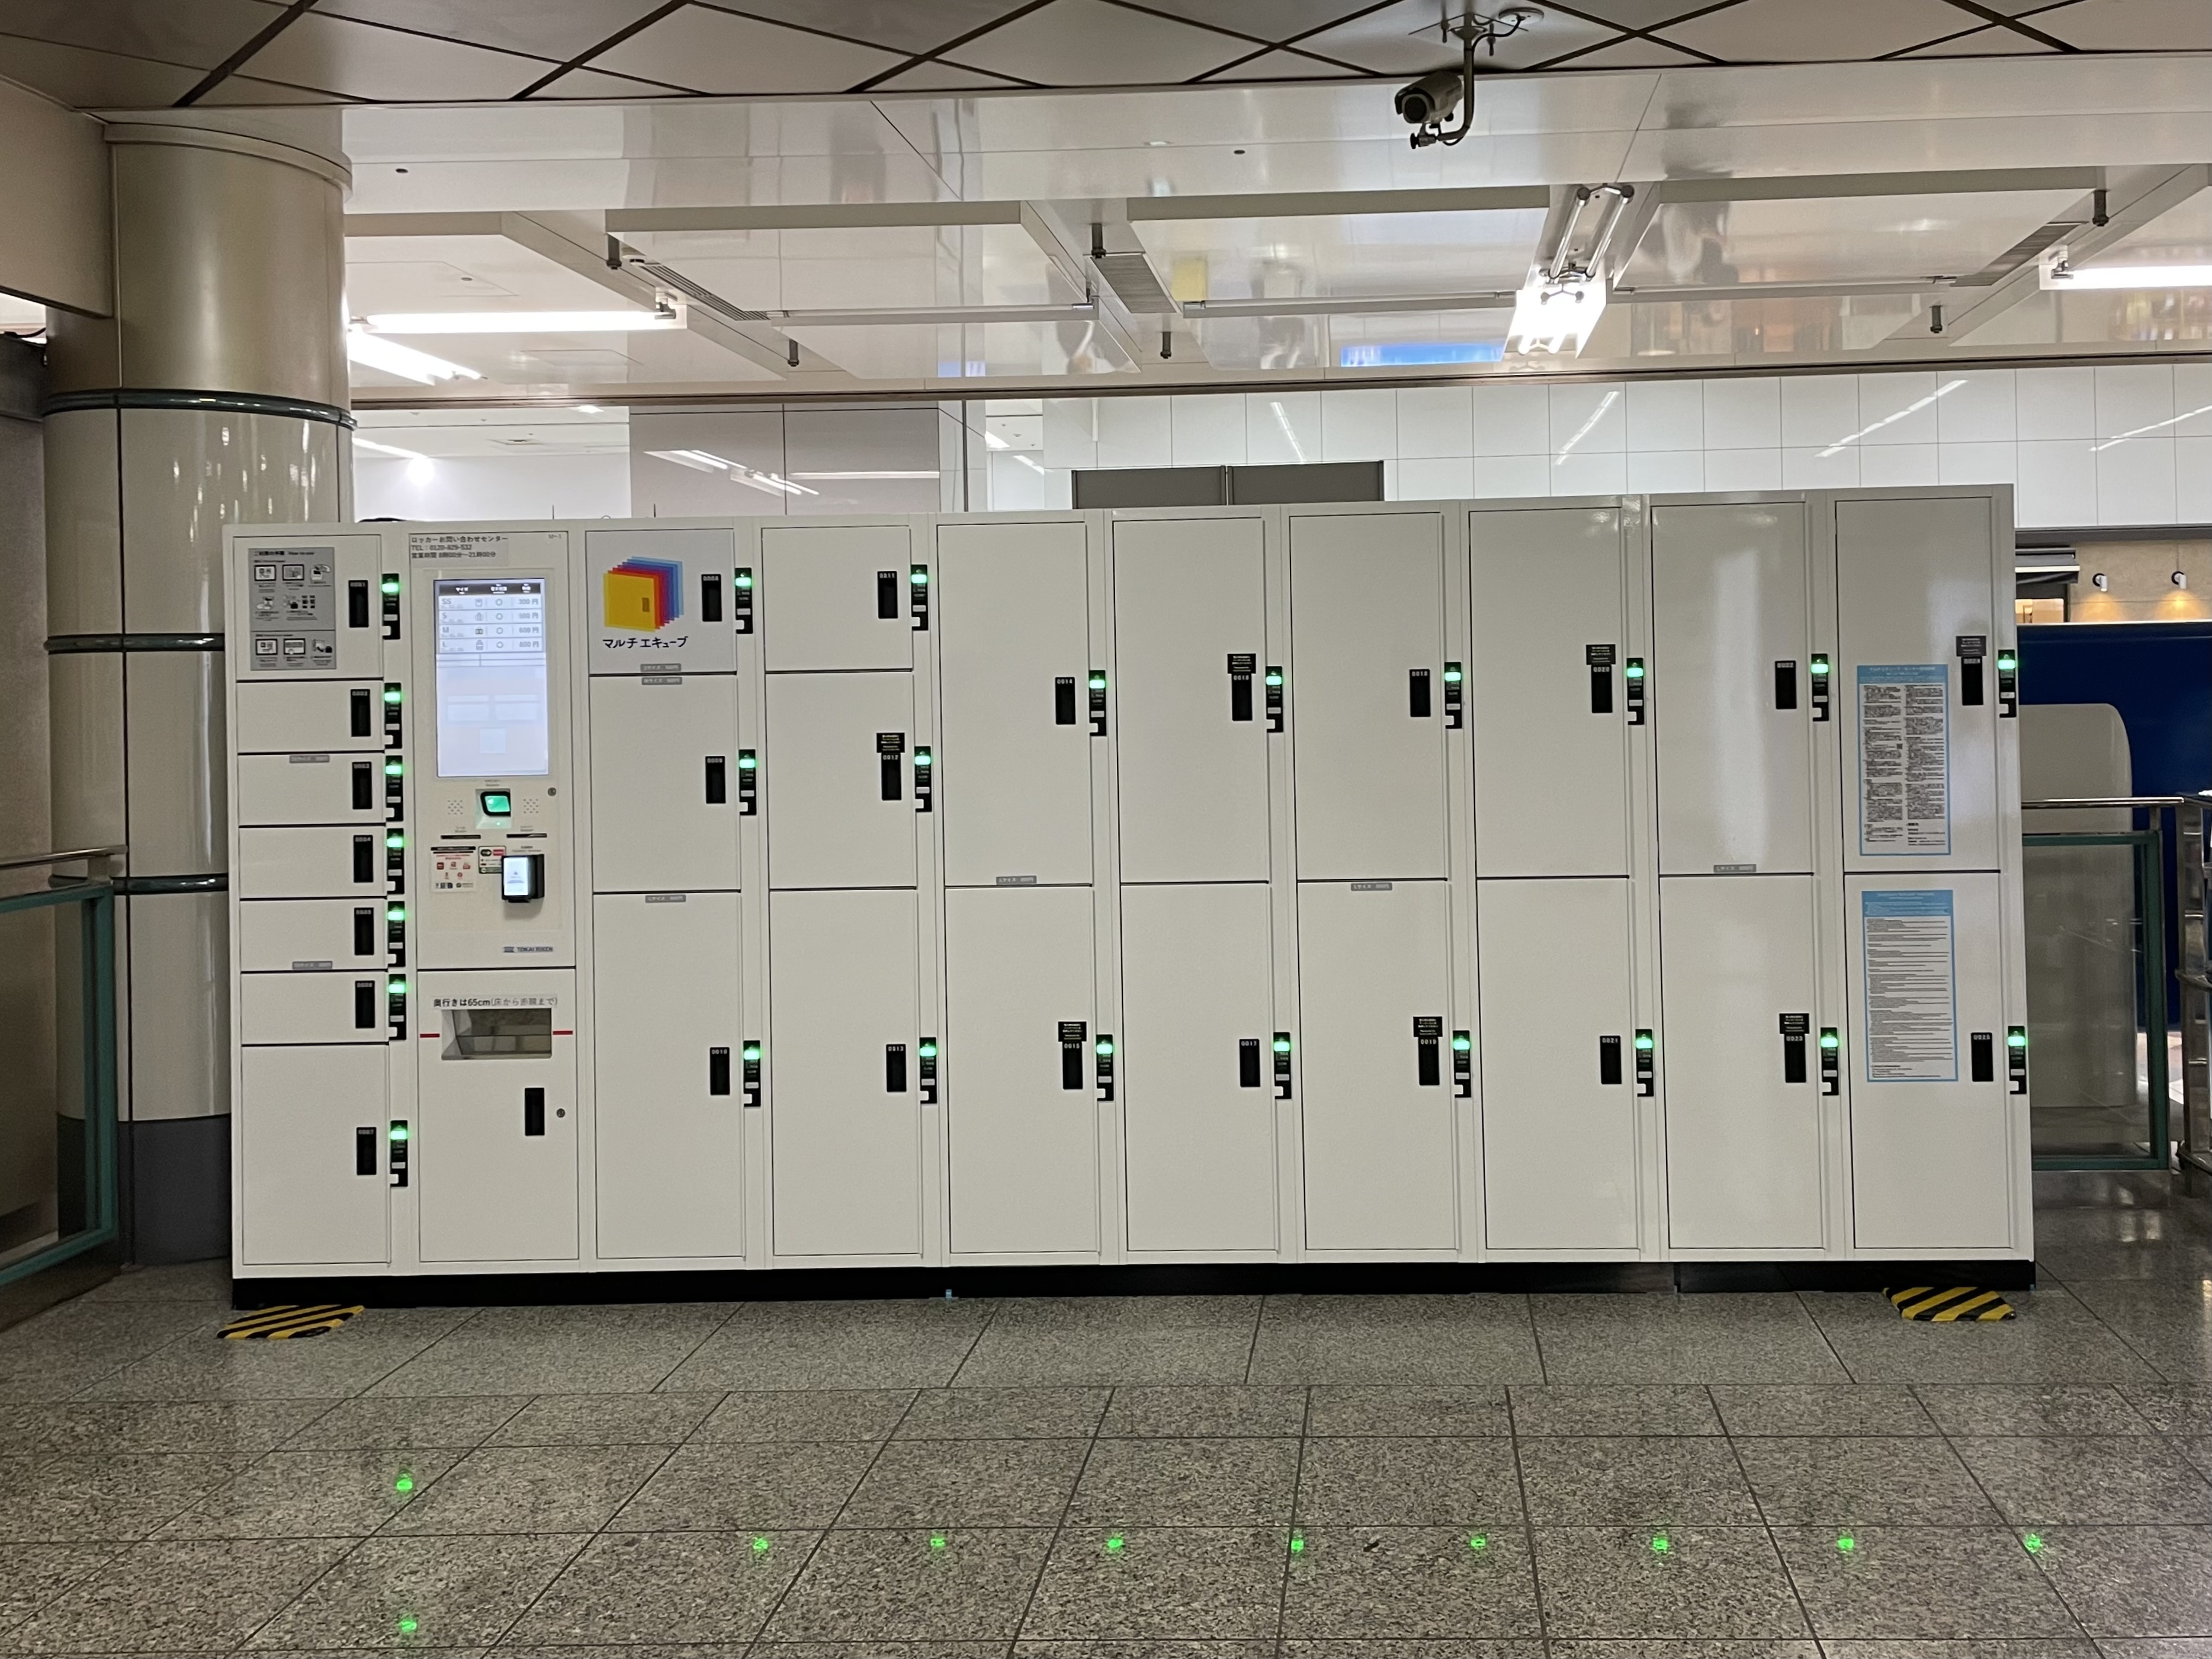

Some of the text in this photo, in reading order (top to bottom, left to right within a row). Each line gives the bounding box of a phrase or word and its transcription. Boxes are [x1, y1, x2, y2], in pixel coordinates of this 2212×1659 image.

[602, 636, 689, 649] マルチエキューブ
